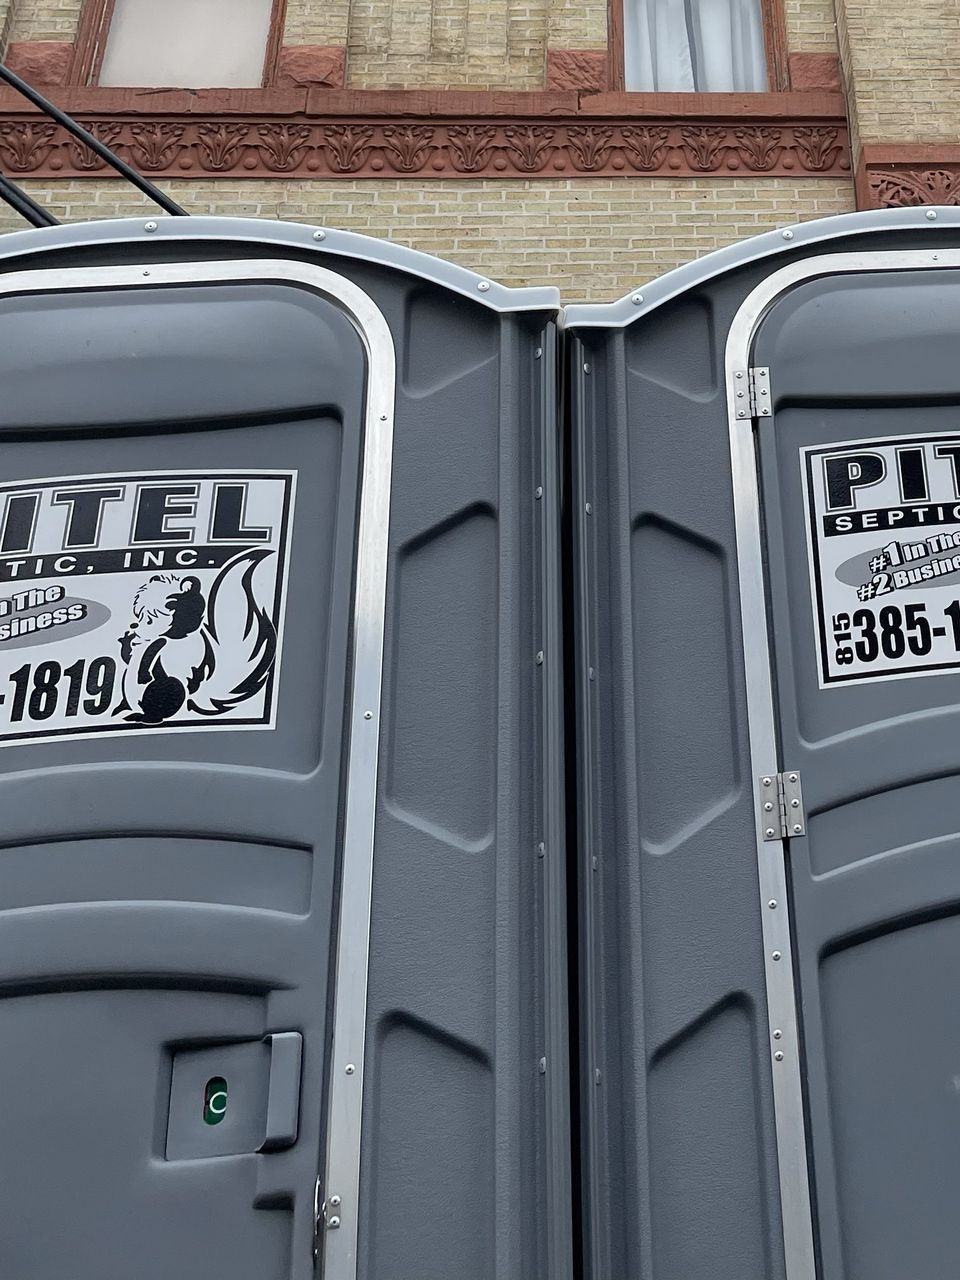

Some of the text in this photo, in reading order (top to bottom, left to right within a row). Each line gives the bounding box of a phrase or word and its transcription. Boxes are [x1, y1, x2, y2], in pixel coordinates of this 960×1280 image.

[123, 549, 215, 568] INC.
[869, 541, 904, 572] #1
[902, 543, 928, 563] In
[12, 585, 65, 612] The
[857, 573, 894, 601] #2
[832, 612, 854, 665] 815
